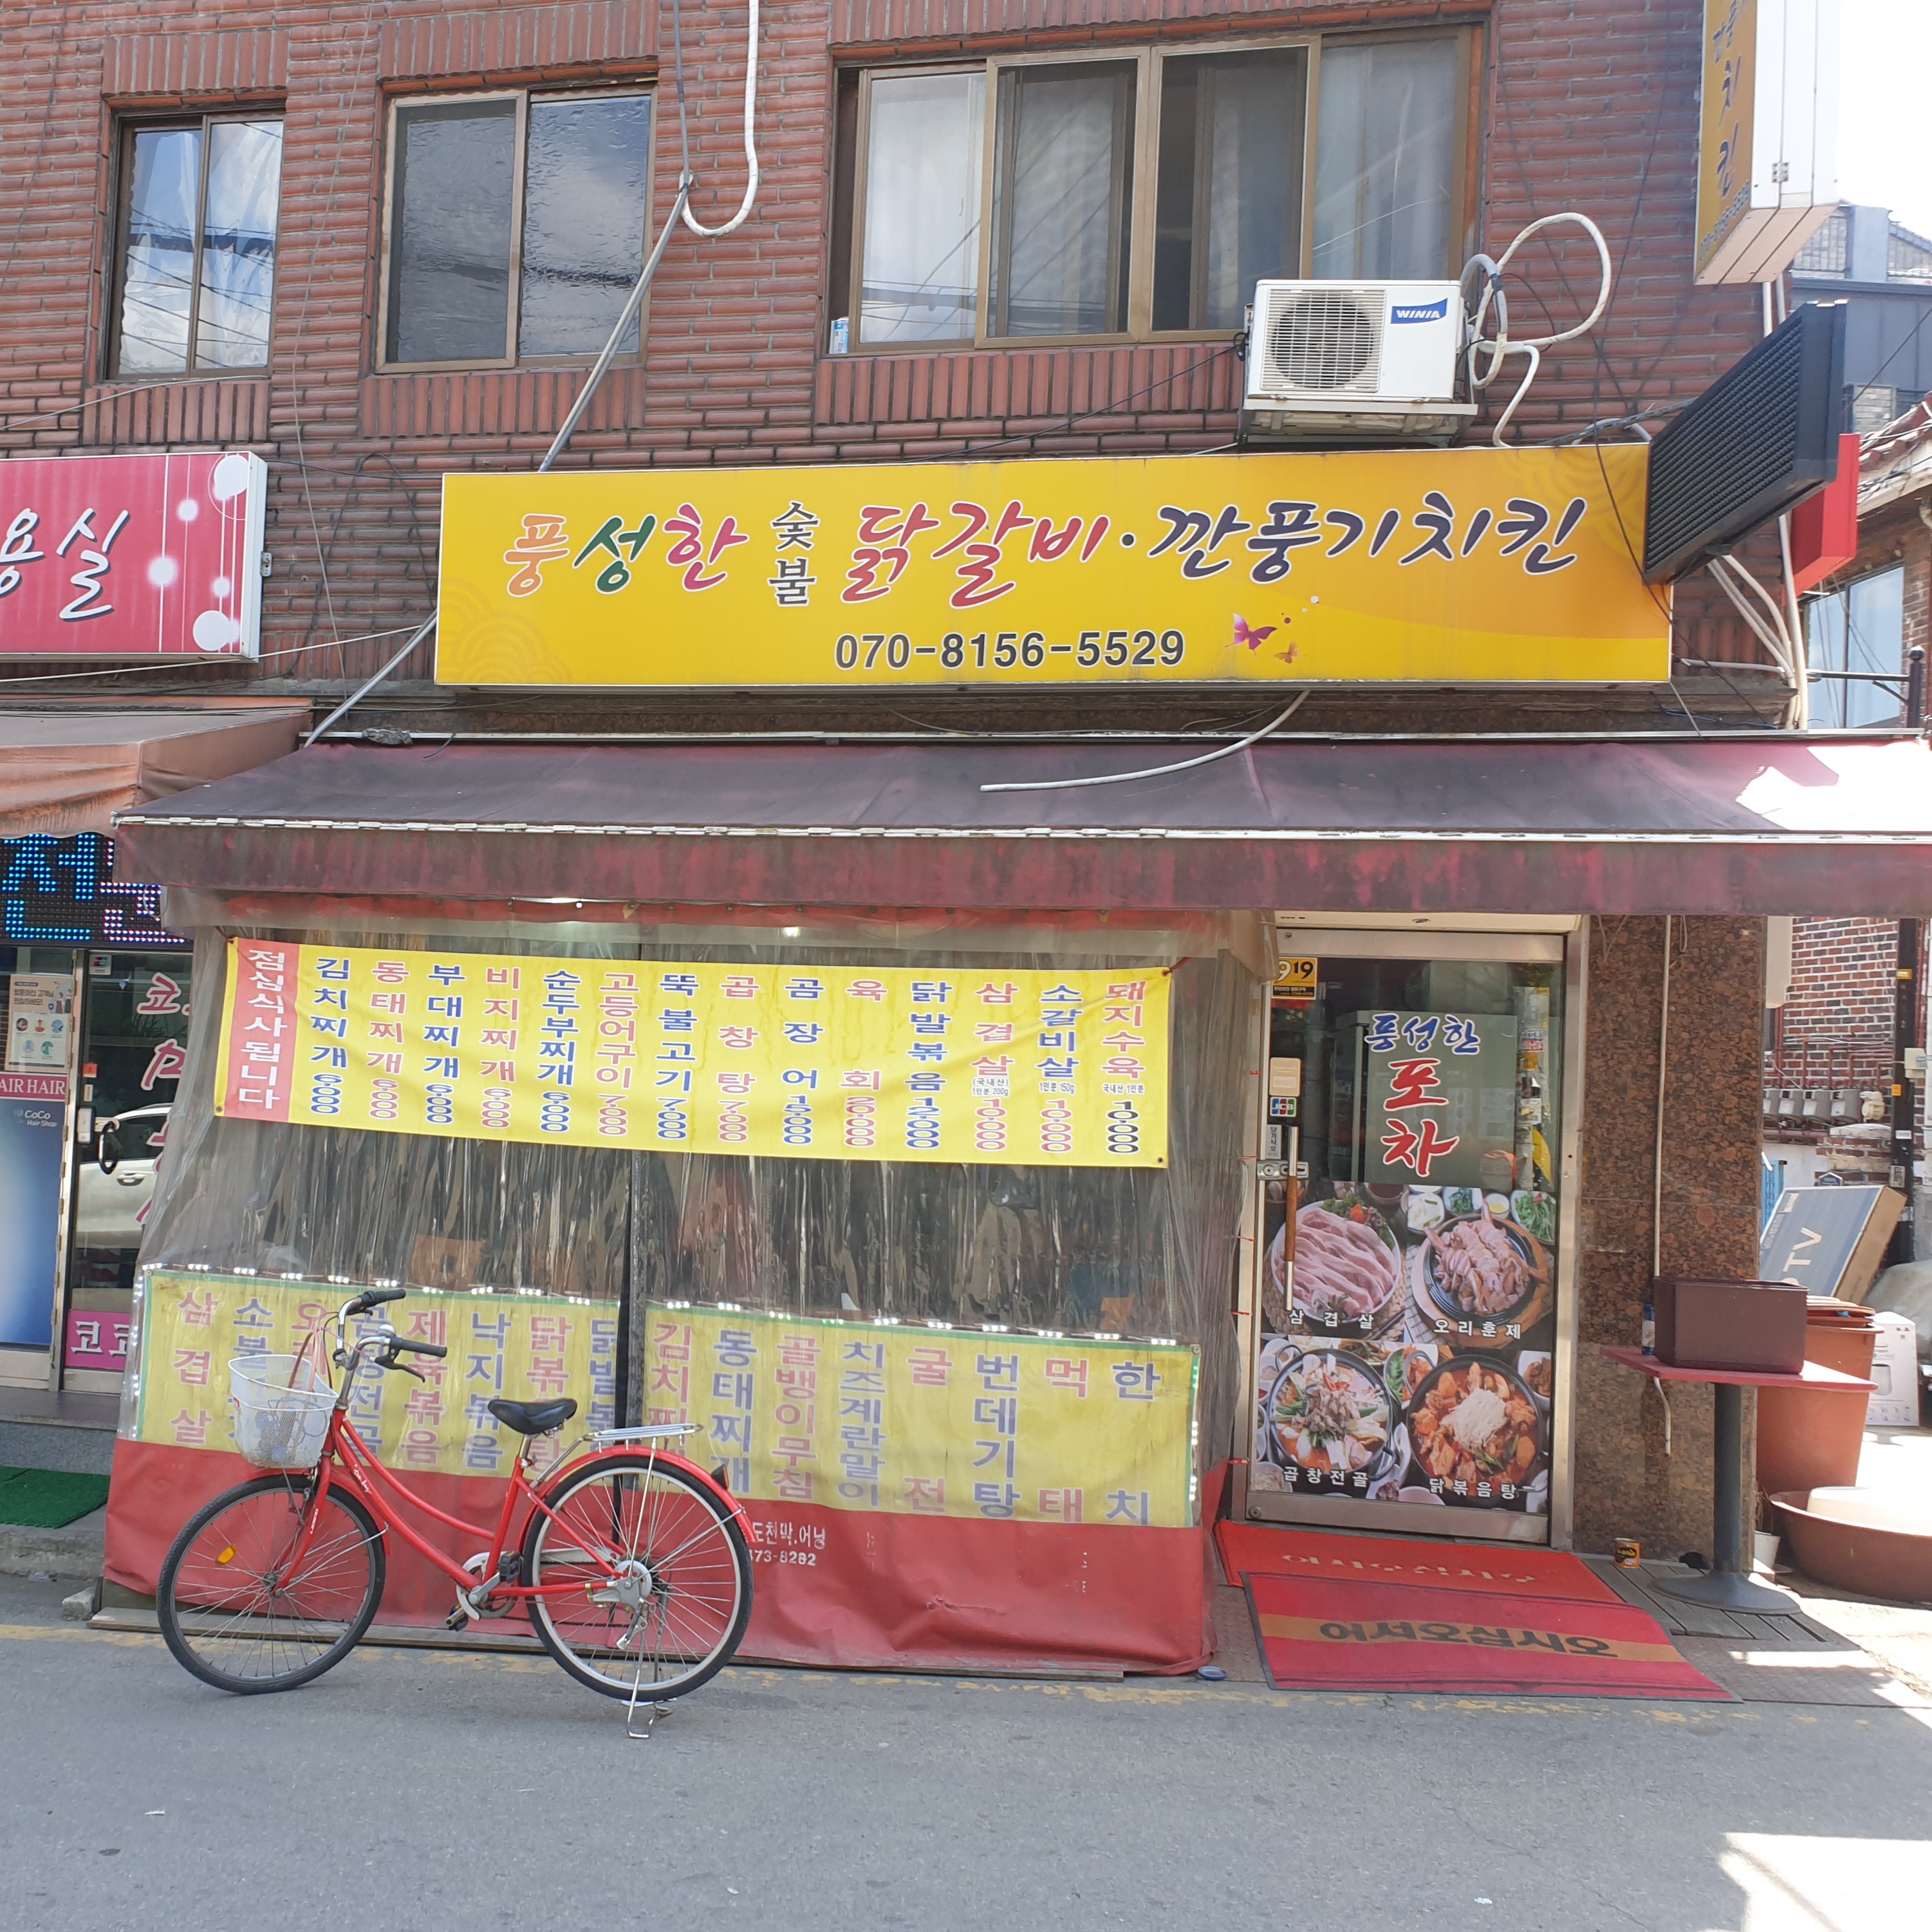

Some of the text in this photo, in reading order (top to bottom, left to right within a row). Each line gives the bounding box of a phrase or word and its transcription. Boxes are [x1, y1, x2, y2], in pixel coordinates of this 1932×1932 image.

[1396, 309, 1441, 319] WINIA
[504, 502, 749, 599] 풍성한
[768, 500, 819, 607] 숯불
[835, 630, 1185, 671] 070-8156-5529
[26, 1079, 66, 1095] HAIR
[310, 958, 350, 1114] 김치찌개 6,000
[366, 961, 410, 1119] 동태찌개 6,000
[422, 964, 466, 1124] 부대찌개 6,000
[479, 967, 521, 1128] 비지찌개 6,000
[536, 970, 581, 1133] 순두부찌개 6,000
[595, 972, 639, 1135] 고등어구이 7,000
[654, 973, 700, 1140] 뚝불고기 7,000
[716, 976, 760, 1142] 곱창탕 7,000
[781, 978, 825, 1145] 곰장어 15,000
[904, 981, 953, 1149] 닭발볶음 12,000
[971, 983, 1019, 1077] 삼겹살
[1036, 984, 1083, 1078] 소갈비살
[1059, 1082, 1075, 1094] 150g
[1101, 980, 1147, 1079] 돼지수육
[1102, 1084, 1124, 1093] 국내산
[1364, 1012, 1480, 1054] 풍성한
[24, 1110, 51, 1119] CoCo
[844, 1096, 876, 1147] 20,000
[976, 1098, 1006, 1151] 10,000
[992, 1088, 1008, 1096] 200g
[1041, 1099, 1072, 1152] 10,000
[1107, 1101, 1139, 1153] 10,000
[1380, 1058, 1460, 1177] 포차
[170, 1291, 218, 1445] 삼겹살
[400, 1310, 448, 1464] 제육볶음
[585, 1319, 617, 1453] 닭발볶
[1434, 1320, 1521, 1340] 오리훈제
[461, 1312, 512, 1470] 낙지볶음
[526, 1316, 573, 1474] 닭볶탕
[647, 1323, 692, 1458] 김치찌
[710, 1329, 757, 1494] 동태찌개
[772, 1334, 822, 1500] 골뱅이무침
[837, 1341, 886, 1507] 치즈계란말이
[972, 1353, 1021, 1518] 번데기탕
[1284, 1467, 1369, 1488] 곱창전골
[1429, 1478, 1516, 1500] 닭볶음탕
[1320, 1622, 1619, 1657] 어서오십시오
